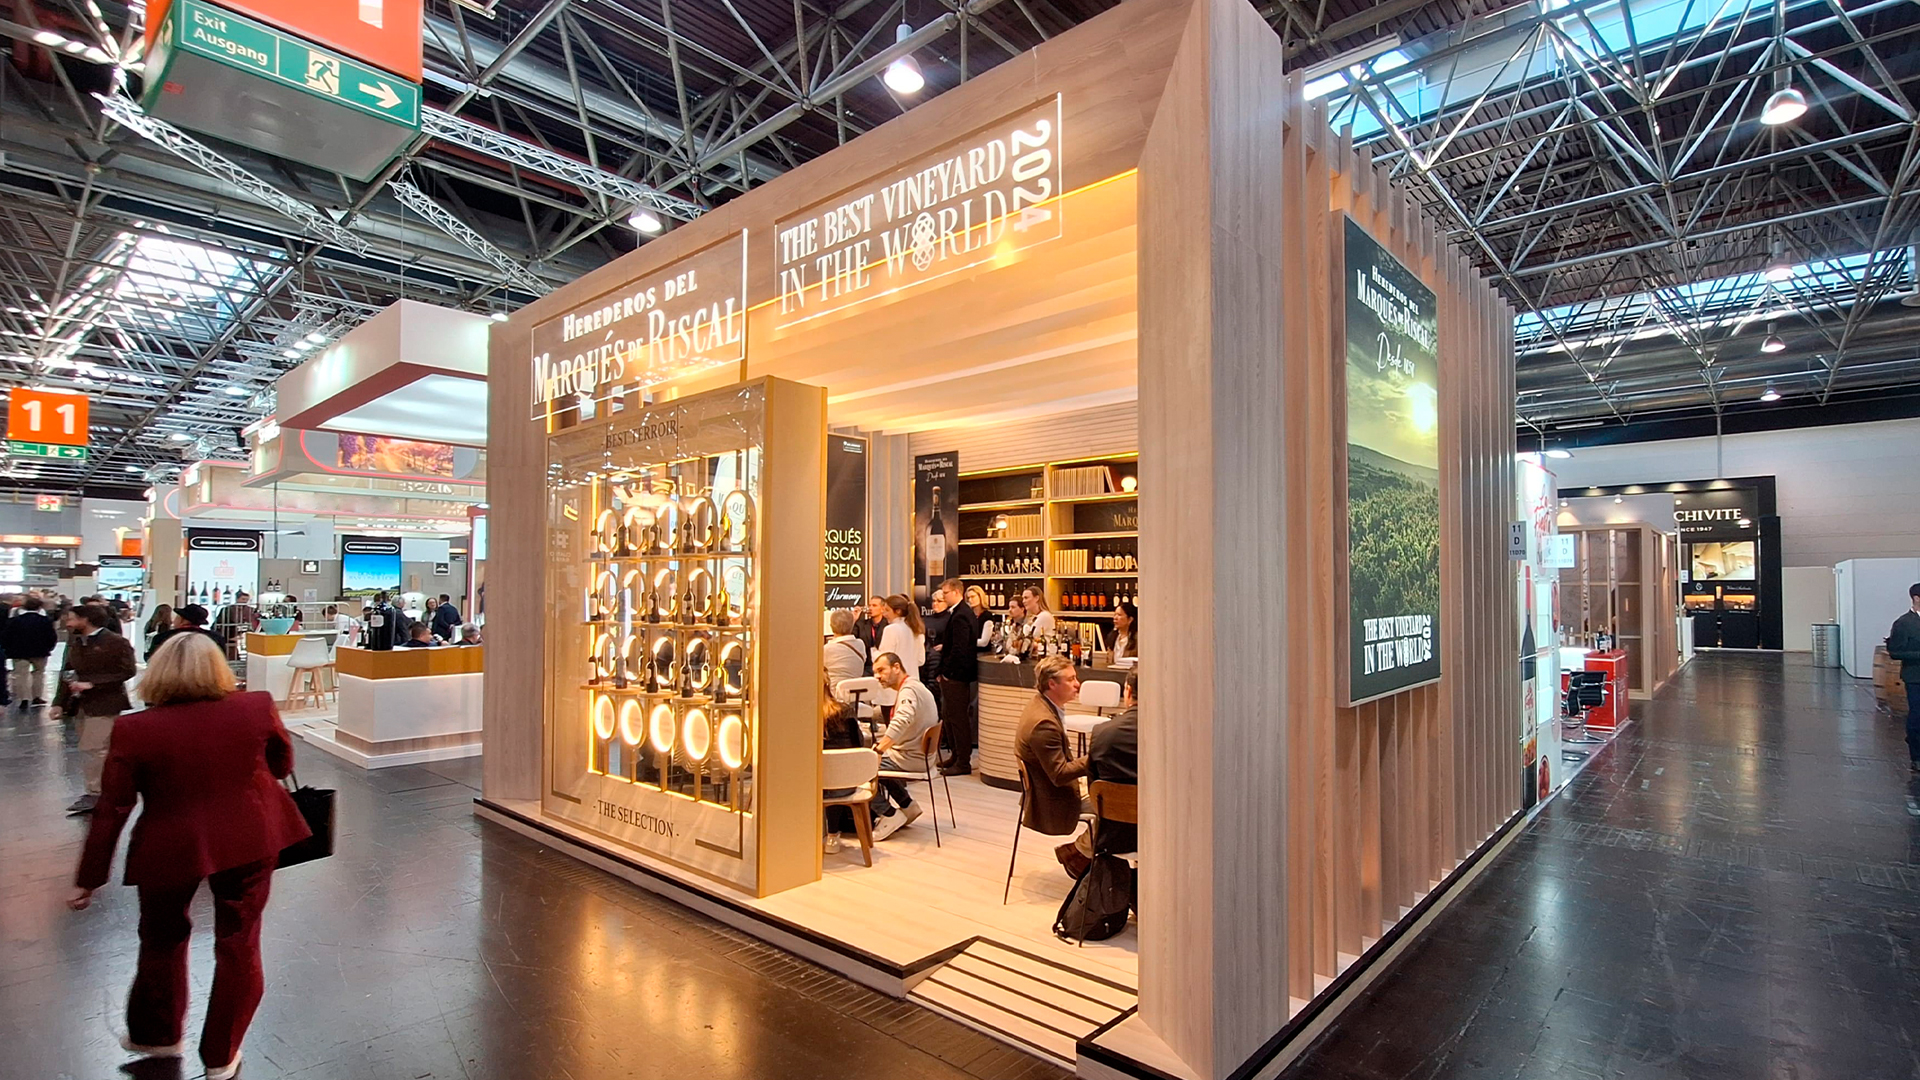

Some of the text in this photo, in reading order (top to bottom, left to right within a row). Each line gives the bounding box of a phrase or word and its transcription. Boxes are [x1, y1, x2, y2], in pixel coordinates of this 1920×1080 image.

[193, 10, 228, 34] Exit
[193, 27, 268, 66] Ausgang
[1011, 119, 1052, 233] 2024
[780, 139, 1006, 265] THE BEST VINEYARD
[780, 189, 1007, 315] IN THE WORLD
[563, 270, 698, 342] HEREDEROS DEL
[1403, 306, 1430, 350] RISCAL
[533, 297, 741, 405] MARQUÉS DE RISCAL
[1376, 332, 1403, 379] Desde
[21, 400, 75, 435] 11
[606, 419, 677, 449] BEST TERROIR
[1512, 525, 1521, 533] 11
[1673, 508, 1742, 522] CHIVITE
[1514, 536, 1520, 545] D
[970, 561, 1042, 575] RUEDA WINES
[827, 587, 862, 606] Harmony
[1363, 614, 1422, 642] THE BEST VINEYARD
[1422, 614, 1432, 661] 2024
[1364, 644, 1375, 675] IN
[1376, 640, 1395, 672] THE
[598, 799, 674, 838] THE SELECTION
